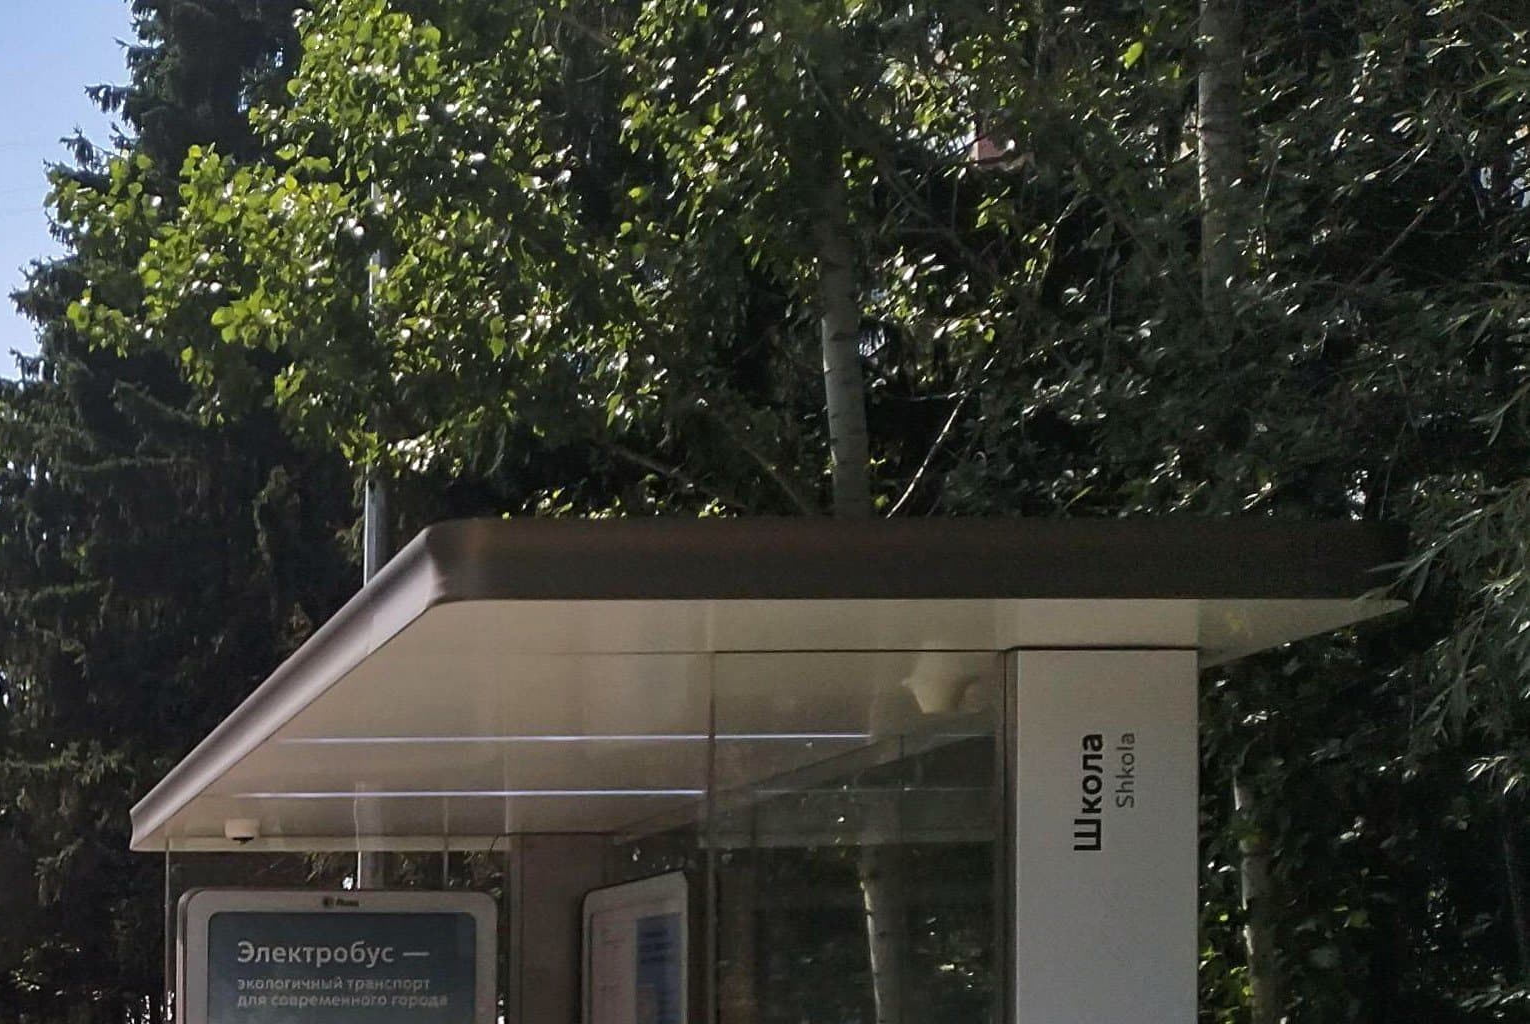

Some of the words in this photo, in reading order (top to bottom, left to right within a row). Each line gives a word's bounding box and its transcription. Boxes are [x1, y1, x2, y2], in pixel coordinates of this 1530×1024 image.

[1115, 732, 1135, 808] Shkola
[1073, 733, 1103, 851] Школа
[237, 940, 395, 968] Электробус
[237, 976, 344, 991] экологичный
[347, 978, 431, 994] транспорт
[237, 994, 268, 1008] для
[271, 994, 388, 1009] современного
